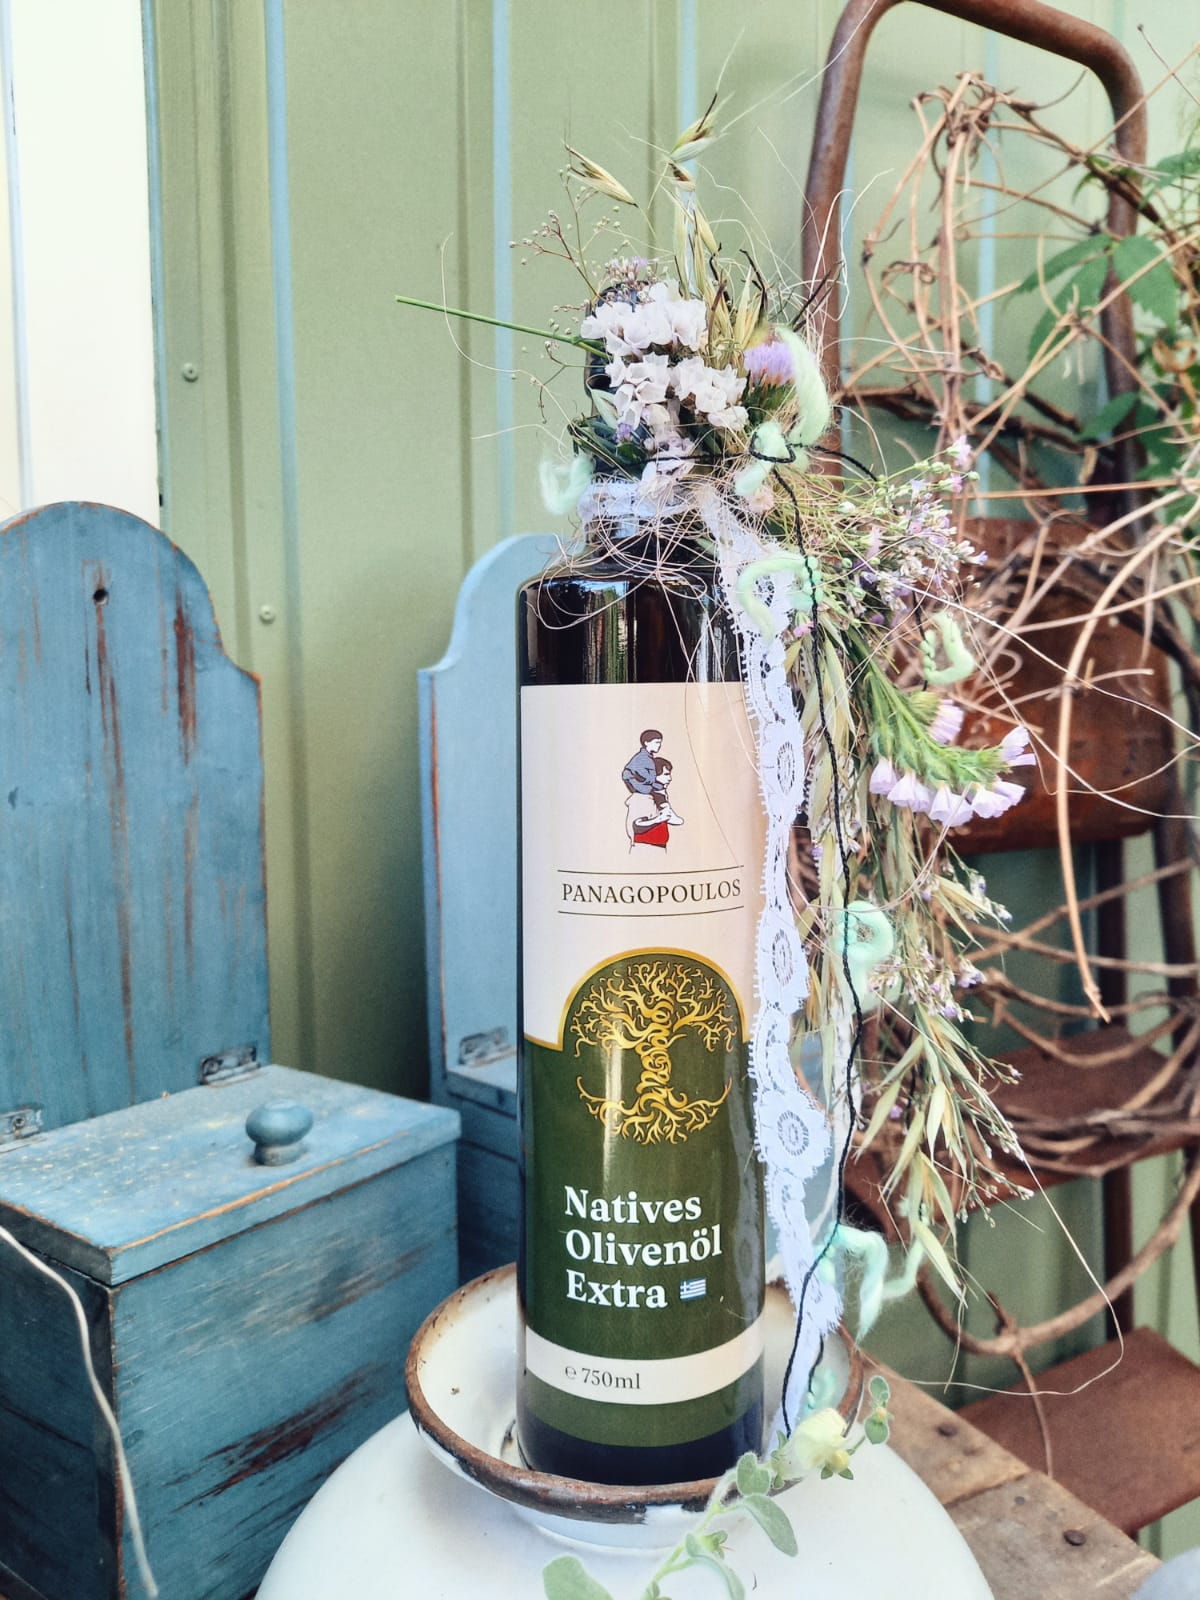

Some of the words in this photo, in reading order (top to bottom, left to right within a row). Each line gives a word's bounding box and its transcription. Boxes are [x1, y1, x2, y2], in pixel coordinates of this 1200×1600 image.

[562, 879, 741, 904] PANAGOPOULOS
[564, 1185, 702, 1224] Natives
[565, 1224, 722, 1267] Olivenöl
[566, 1269, 668, 1309] Extra
[581, 1367, 641, 1390] 750ml
